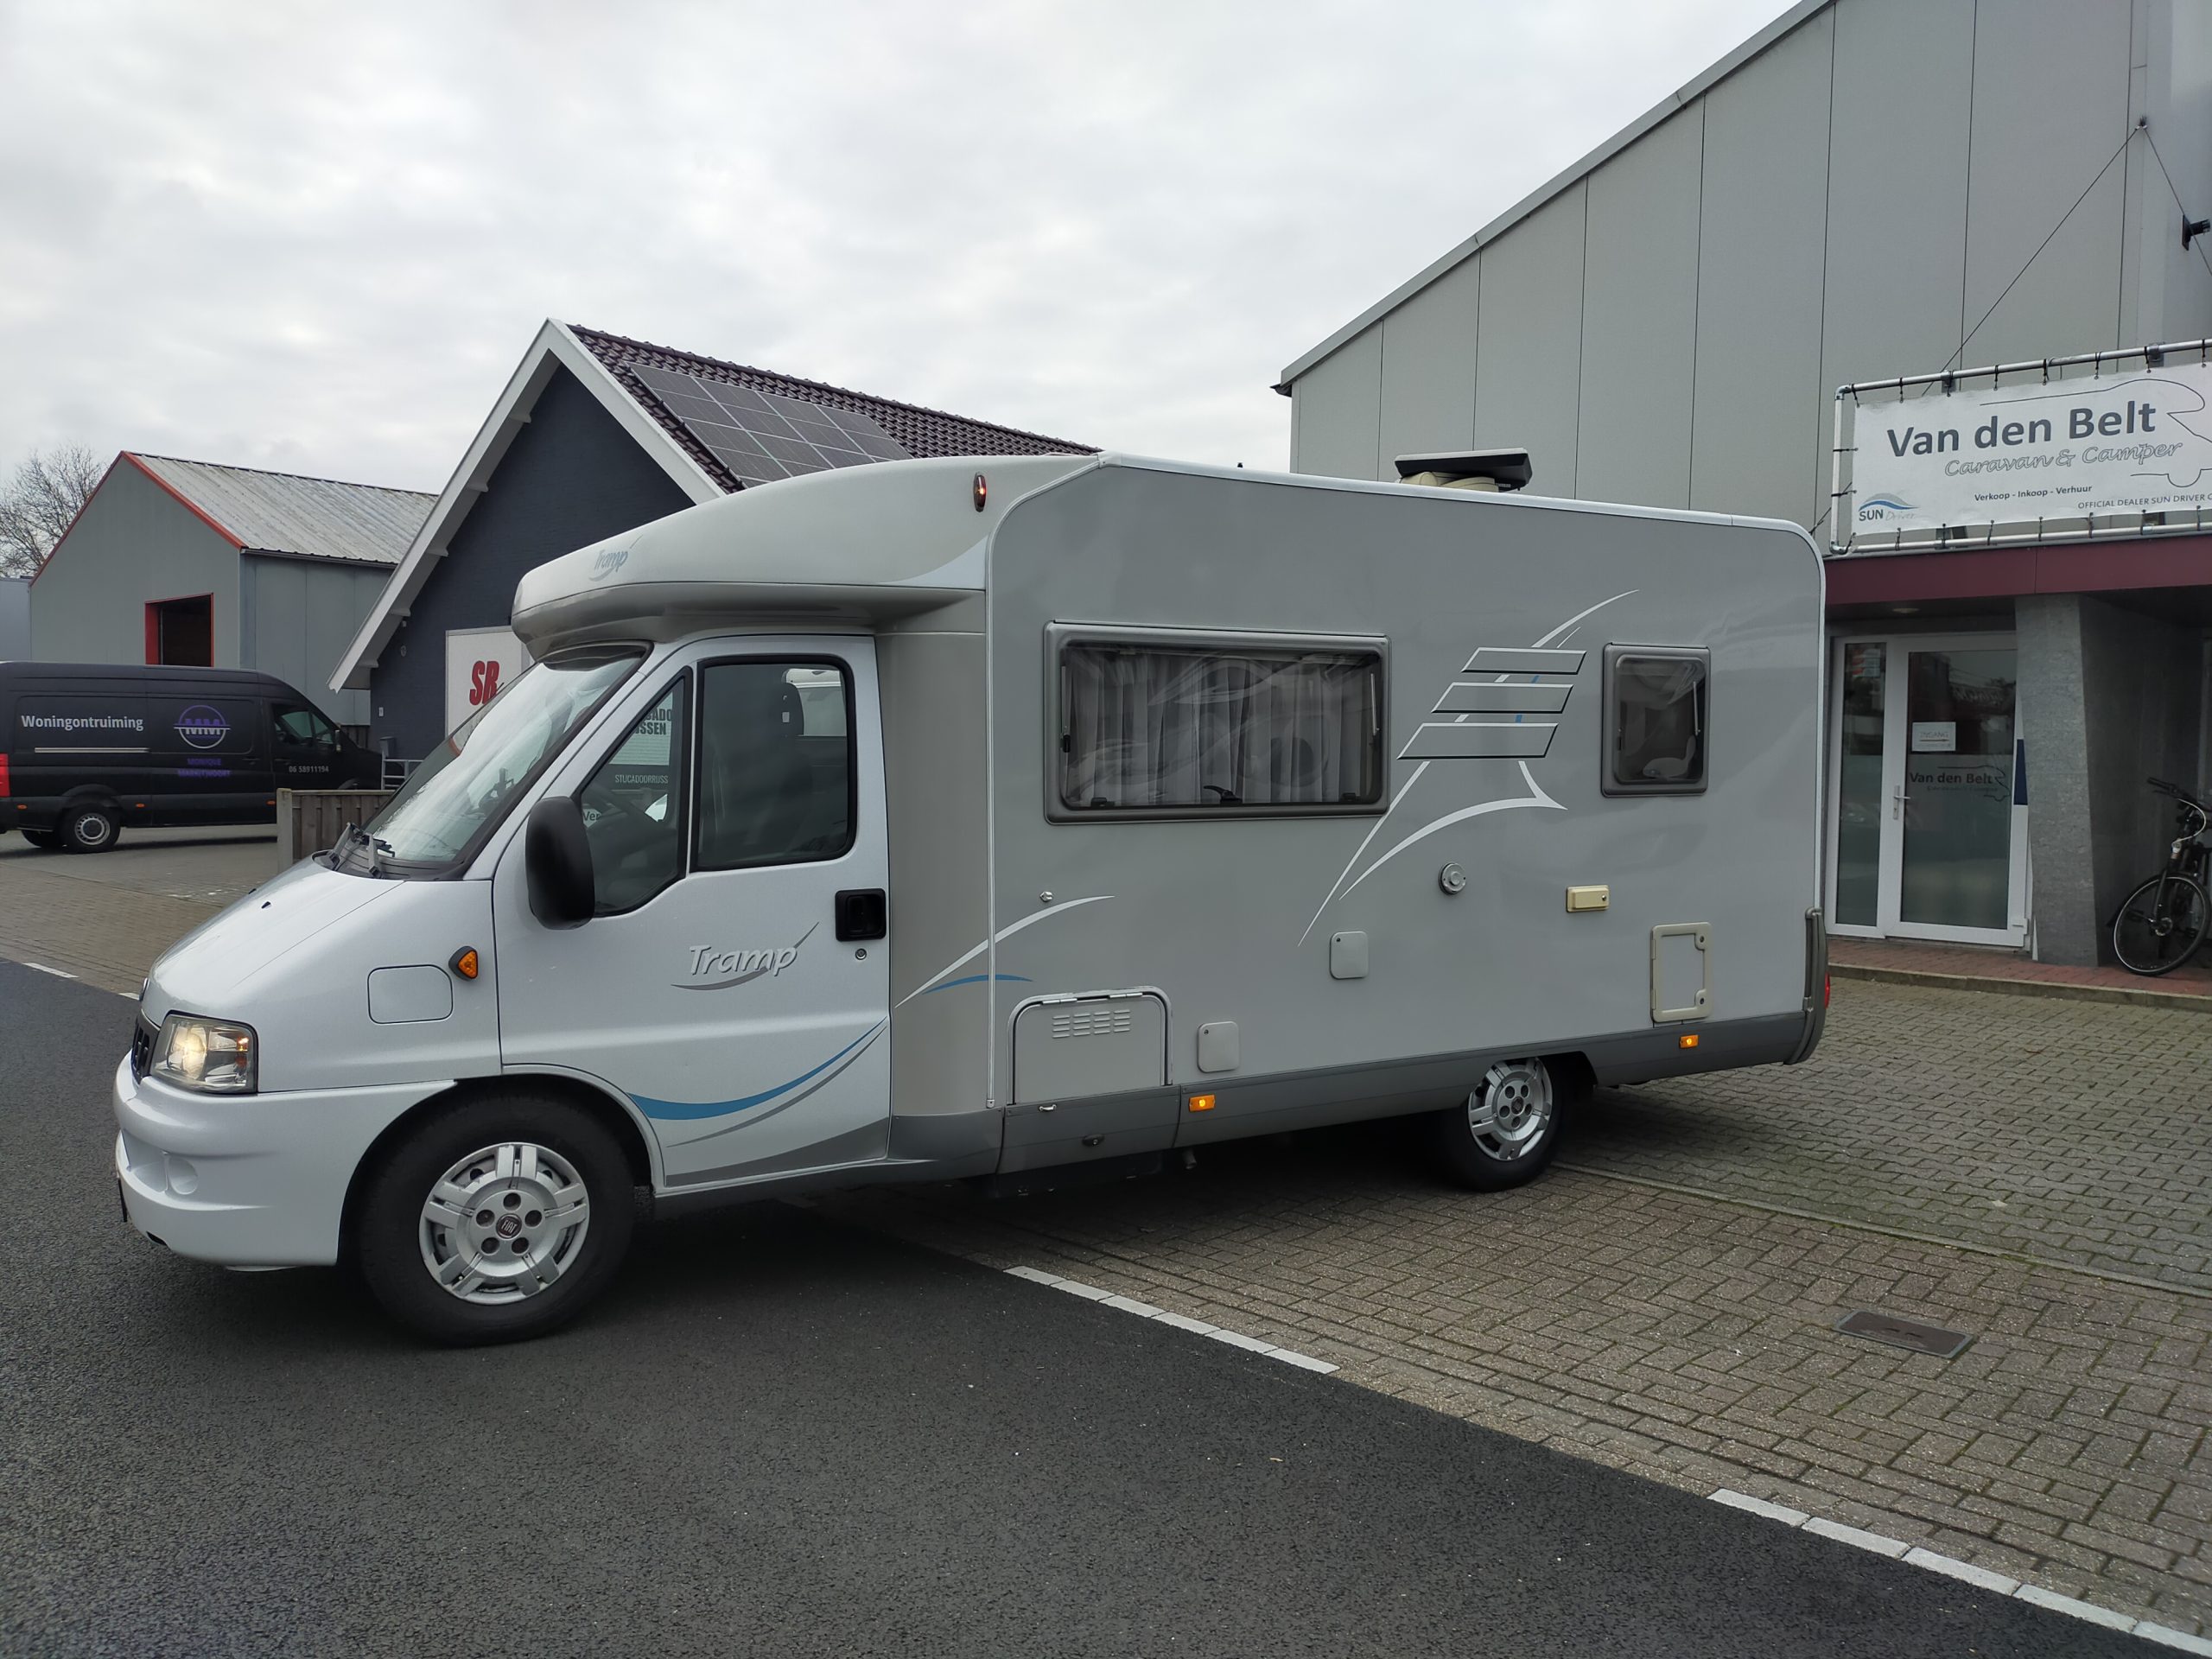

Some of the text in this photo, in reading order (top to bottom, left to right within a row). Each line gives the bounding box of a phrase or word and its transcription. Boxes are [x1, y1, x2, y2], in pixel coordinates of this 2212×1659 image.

[1886, 400, 2157, 457] Van den Belt
[1944, 442, 2183, 477] Caravan & Camper
[1974, 493, 2011, 502] Verkoop
[2018, 489, 2049, 499] Inkoop
[2056, 486, 2093, 494] Verhuur
[2077, 500, 2115, 509] OFFICIAL
[2117, 498, 2150, 506] DEALER
[2151, 495, 2171, 505] SUN
[2172, 493, 2205, 502] DRIVER
[1859, 509, 1884, 522] SUN
[468, 660, 500, 706] SR
[20, 715, 144, 732] Woningontruiming
[1910, 772, 1993, 785] Van den Belt
[689, 944, 798, 977] Tramp
[501, 1219, 518, 1234] FIAT
